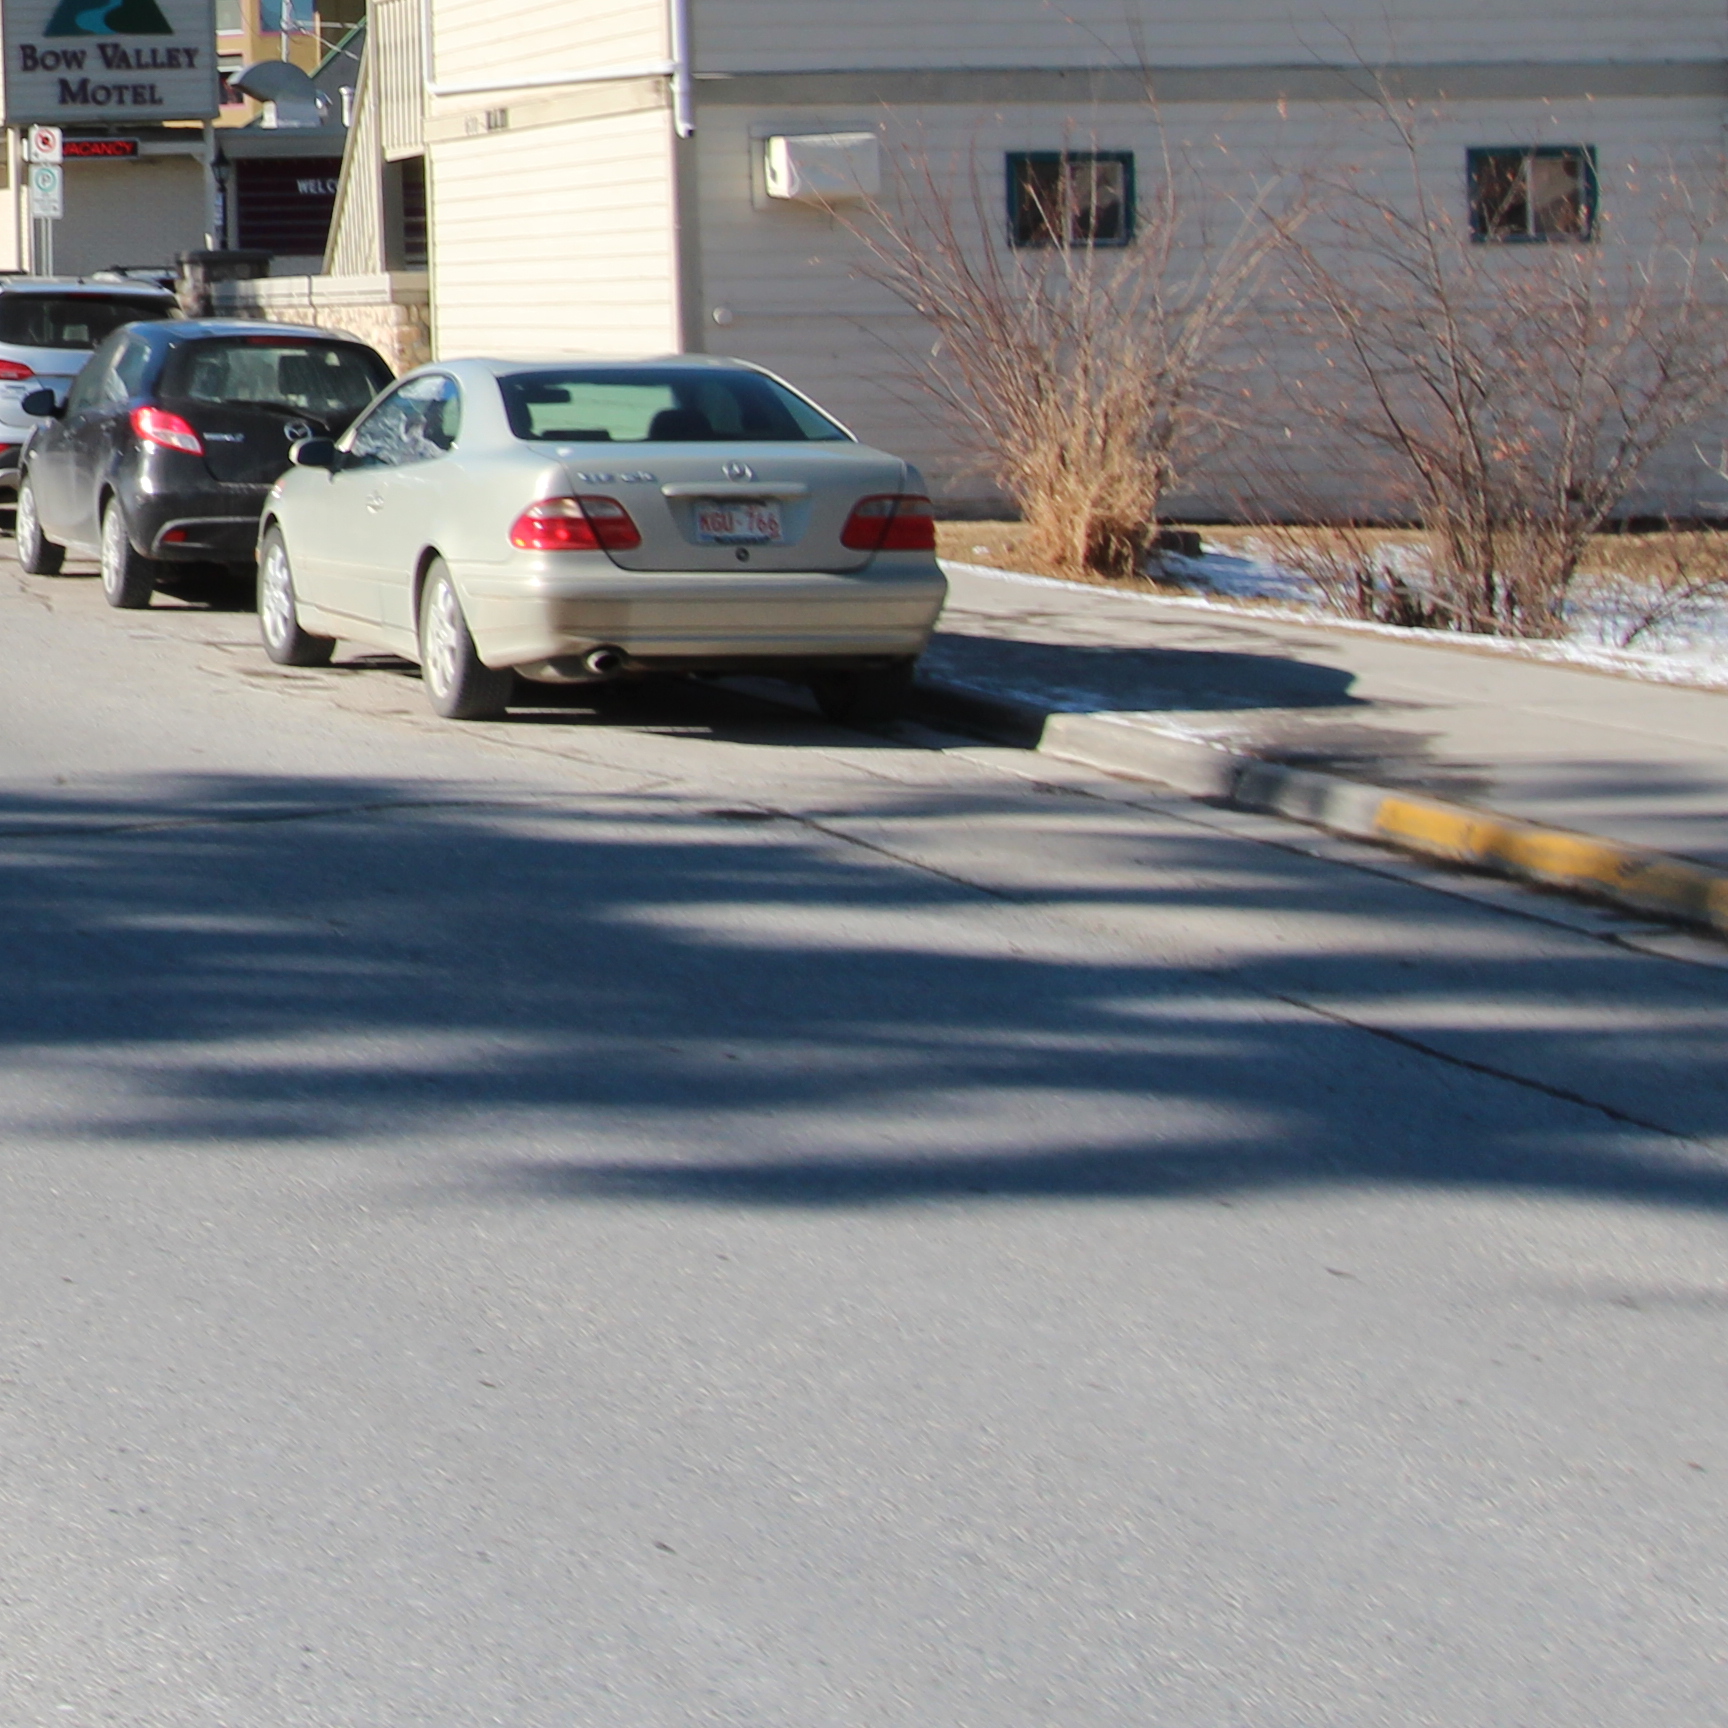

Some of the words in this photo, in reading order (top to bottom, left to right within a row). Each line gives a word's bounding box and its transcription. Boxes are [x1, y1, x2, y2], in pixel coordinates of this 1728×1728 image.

[19, 43, 87, 72] BOW
[97, 42, 199, 70] VALLEY
[58, 77, 164, 106] MOTEL
